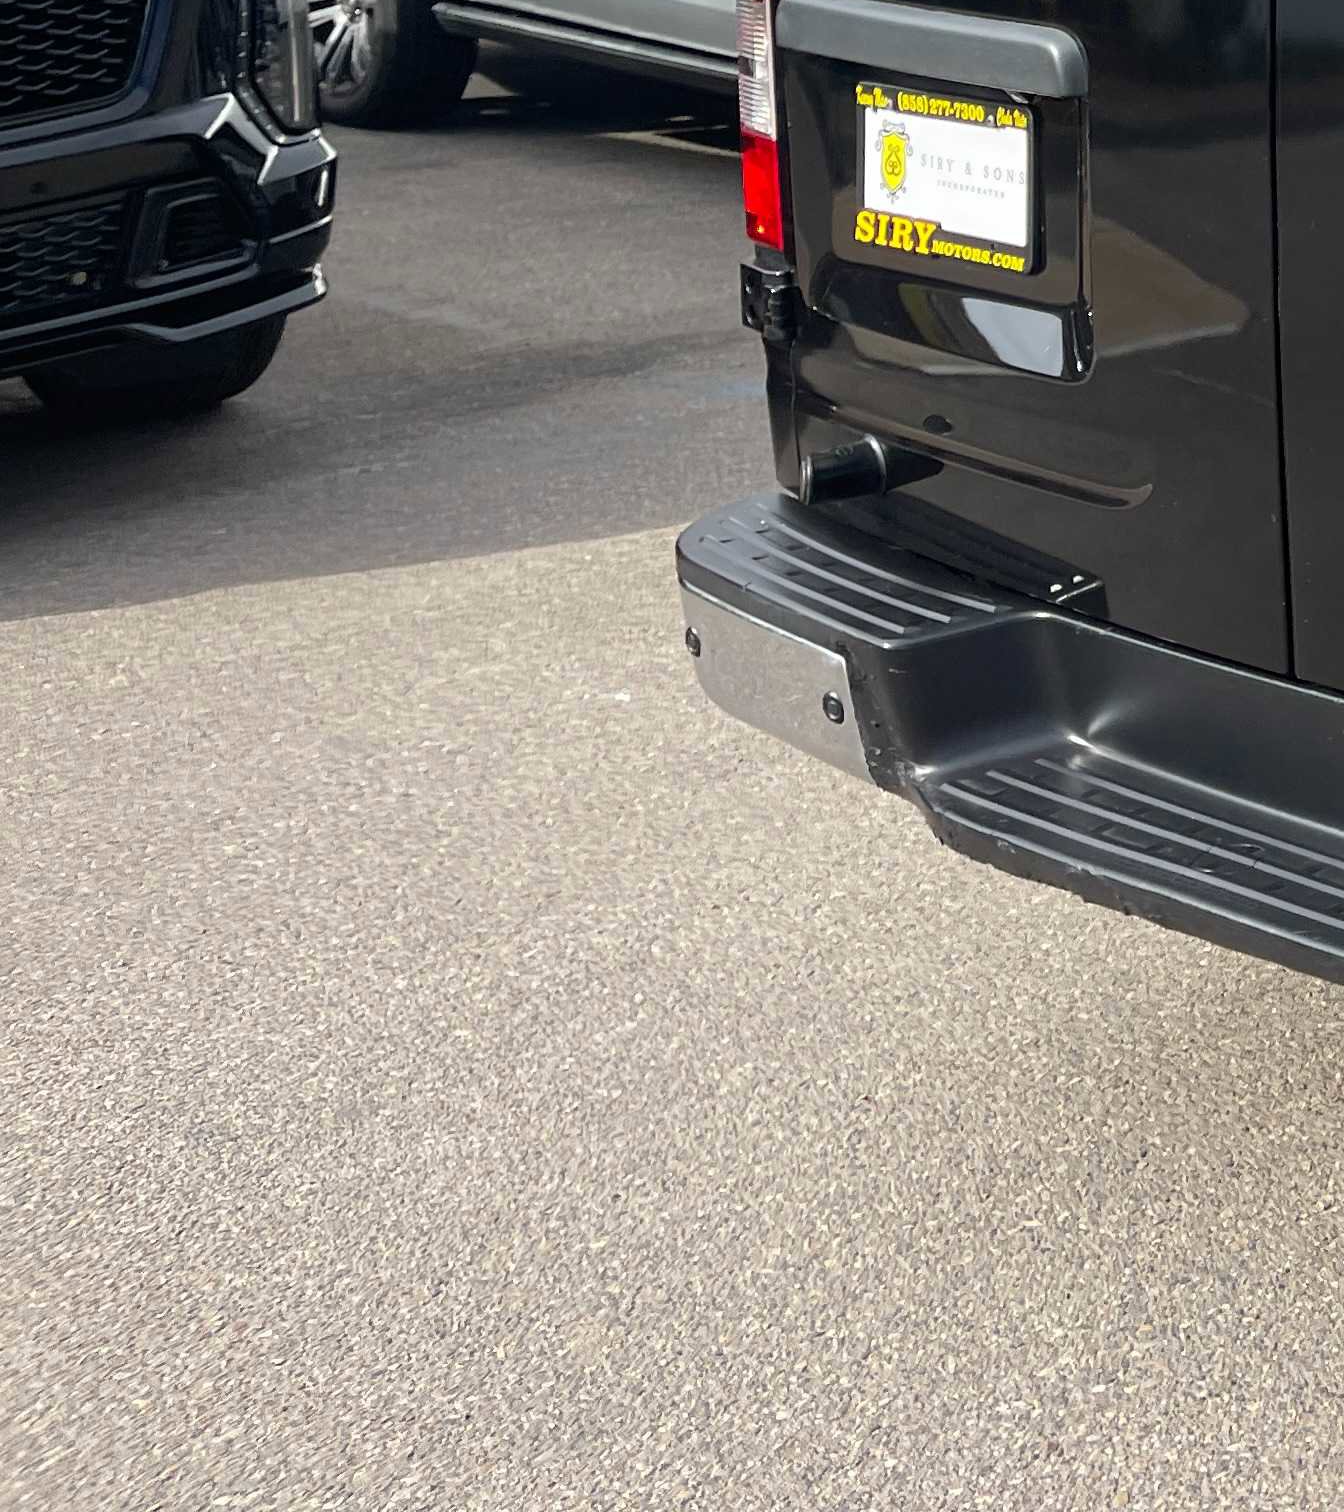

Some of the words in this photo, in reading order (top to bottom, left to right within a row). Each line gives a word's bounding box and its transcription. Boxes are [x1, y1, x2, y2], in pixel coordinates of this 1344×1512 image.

[920, 153, 954, 173] SIRY
[984, 165, 1025, 185] SONS
[855, 210, 937, 255] SIRY
[931, 239, 1025, 272] MOTORS.COM
